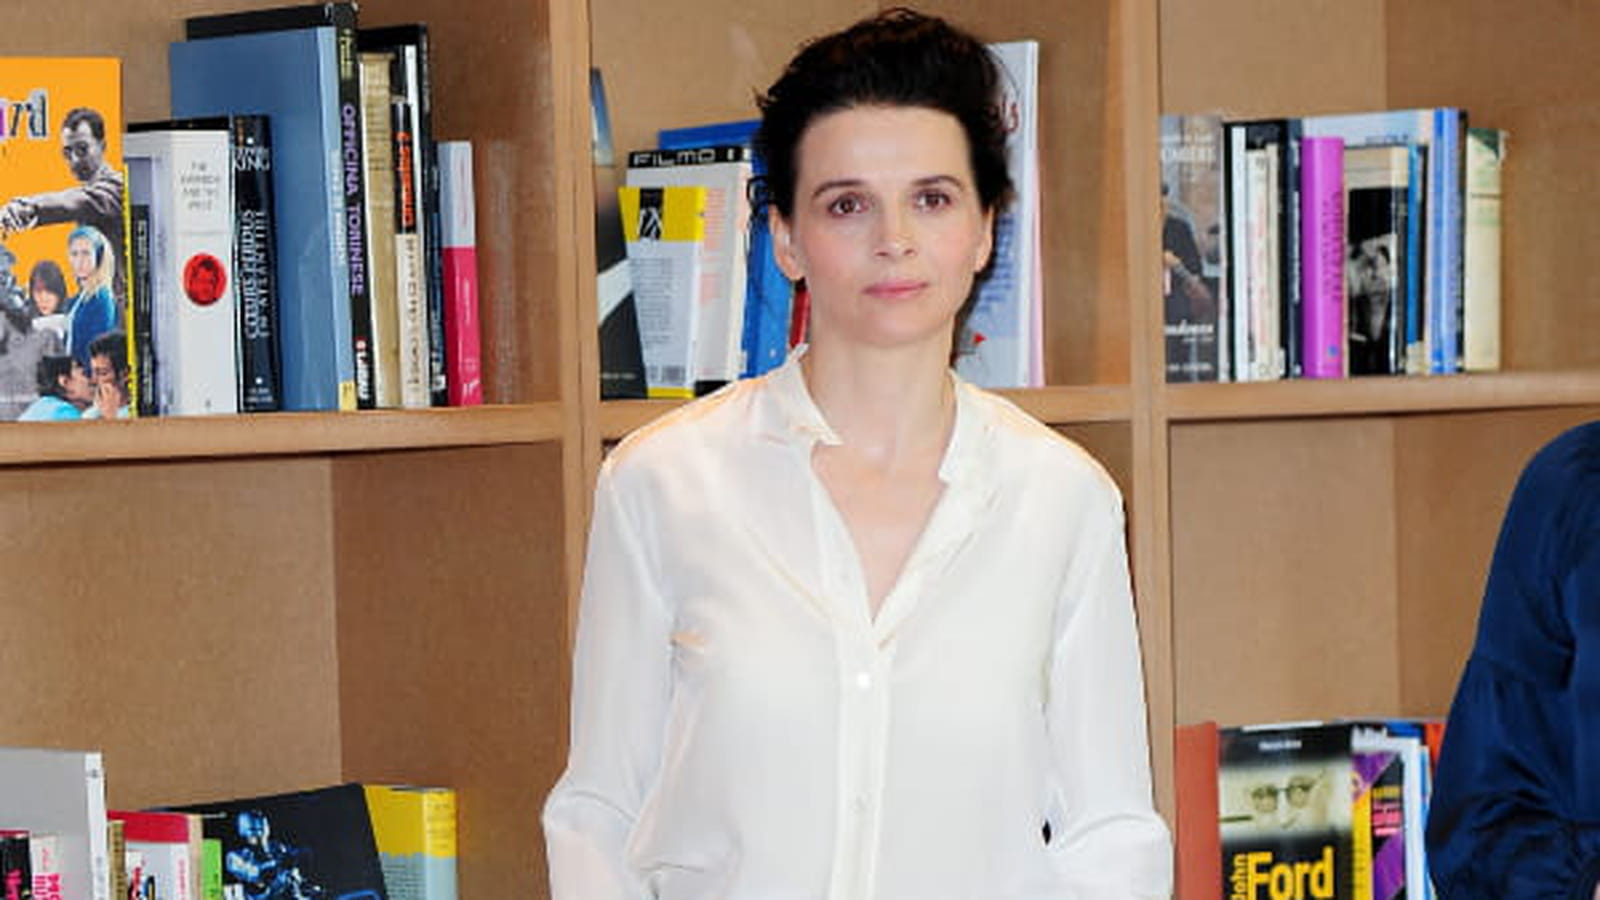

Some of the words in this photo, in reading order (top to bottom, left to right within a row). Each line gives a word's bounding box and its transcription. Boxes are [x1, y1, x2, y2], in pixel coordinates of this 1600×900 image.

[342, 103, 359, 195] OFFICINA
[348, 202, 364, 297] TORINESE
[1247, 845, 1334, 900] Ford
